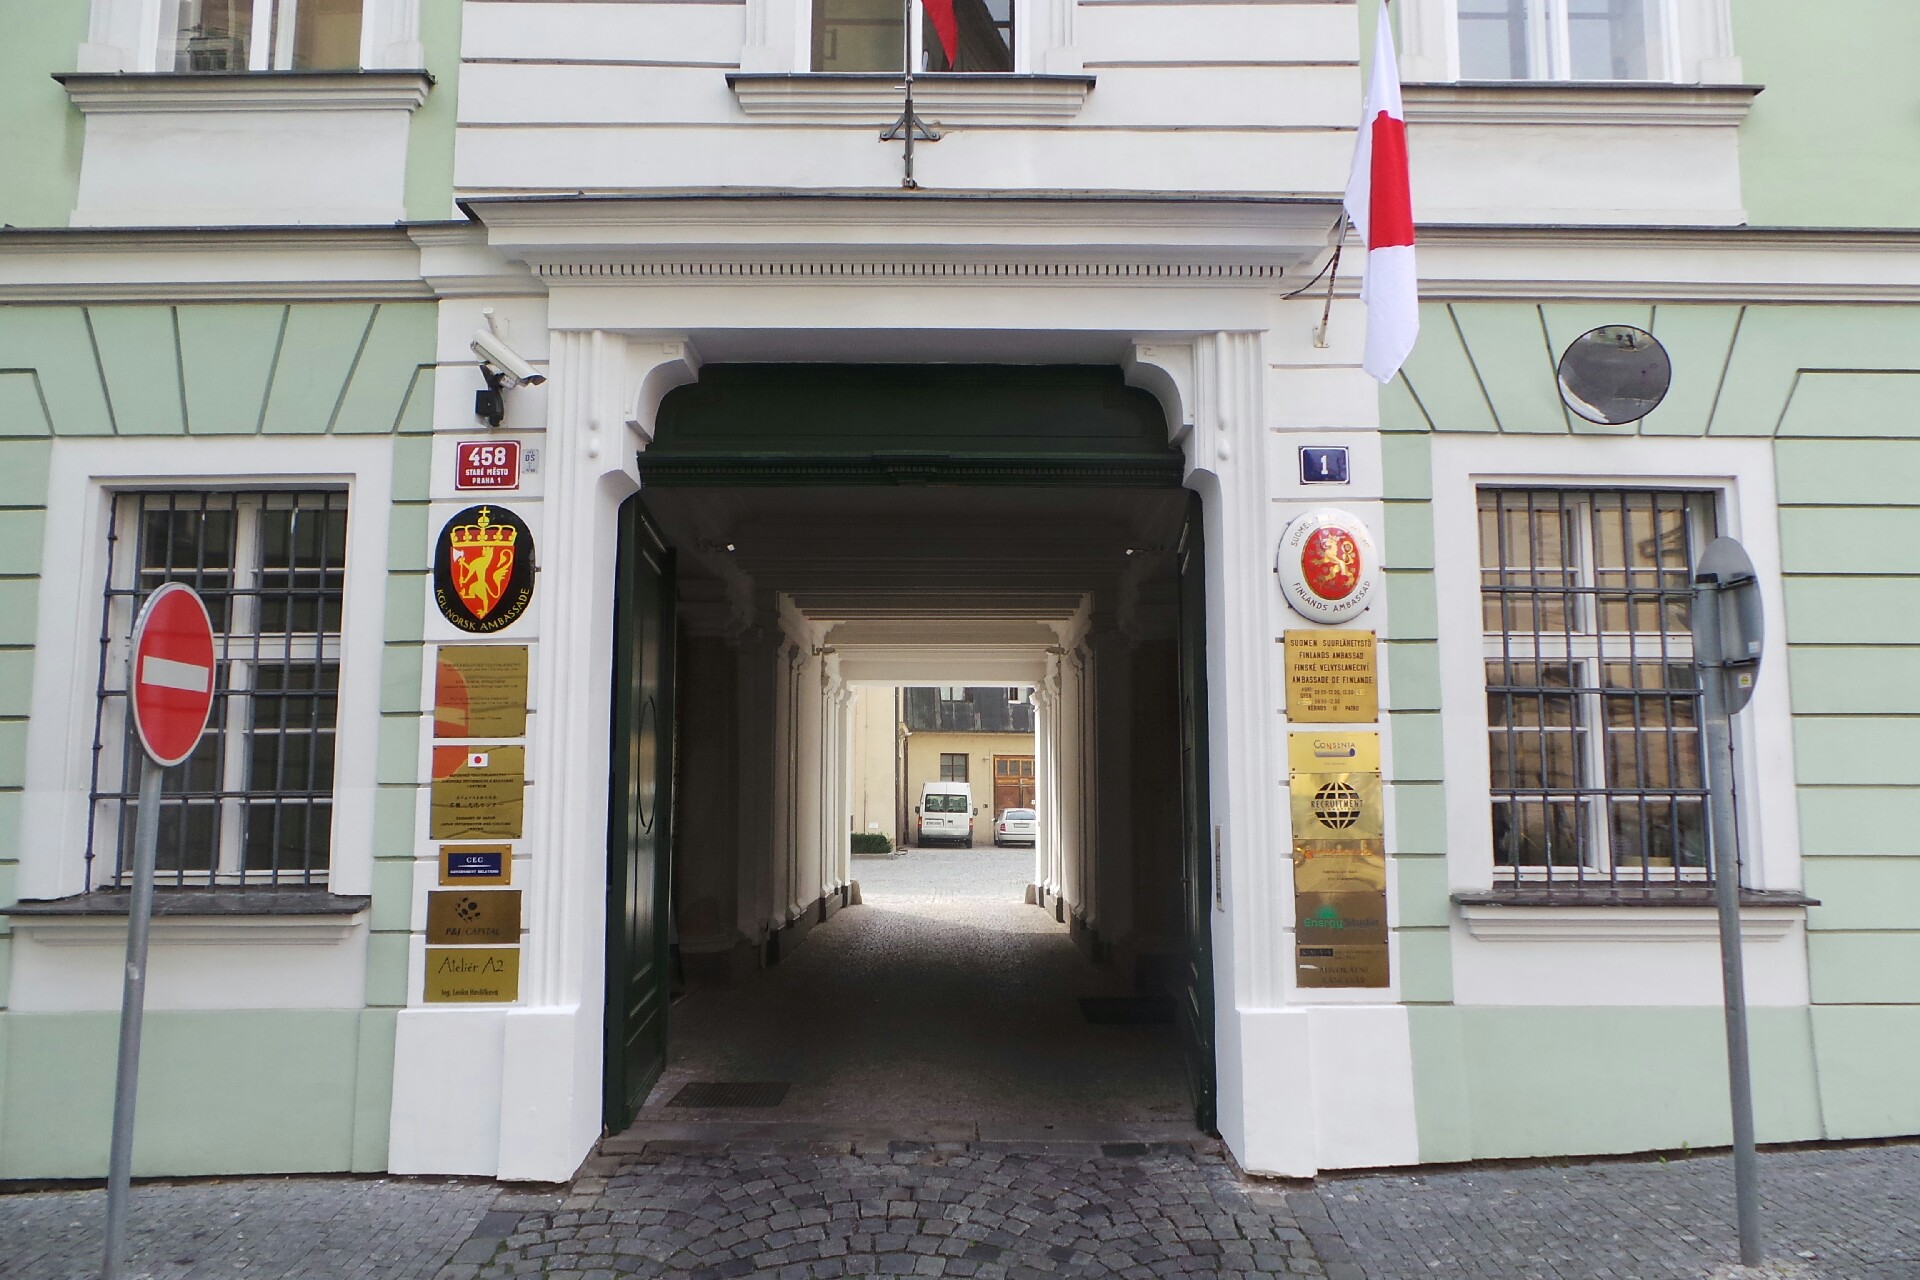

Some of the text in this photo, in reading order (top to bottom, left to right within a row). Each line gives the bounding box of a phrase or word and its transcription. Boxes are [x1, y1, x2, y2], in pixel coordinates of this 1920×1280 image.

[468, 446, 506, 466] 458
[1320, 454, 1329, 475] 1
[465, 467, 509, 476] STARÉ MĚSTO
[1293, 580, 1371, 613] FINLANDS AMBASSAD
[445, 609, 476, 631] NORSK
[480, 587, 530, 631] AMBASSADE
[1290, 639, 1318, 647] SUOMEN
[1299, 651, 1364, 660] FINLANDS AMBASSAD
[1294, 662, 1317, 672] FINSKÉ
[1292, 676, 1373, 684] AMBASSADE DE FINLANDE
[1311, 800, 1363, 808] RECRUITMENT
[464, 927, 500, 936] CAPITAL
[481, 956, 504, 974] A2
